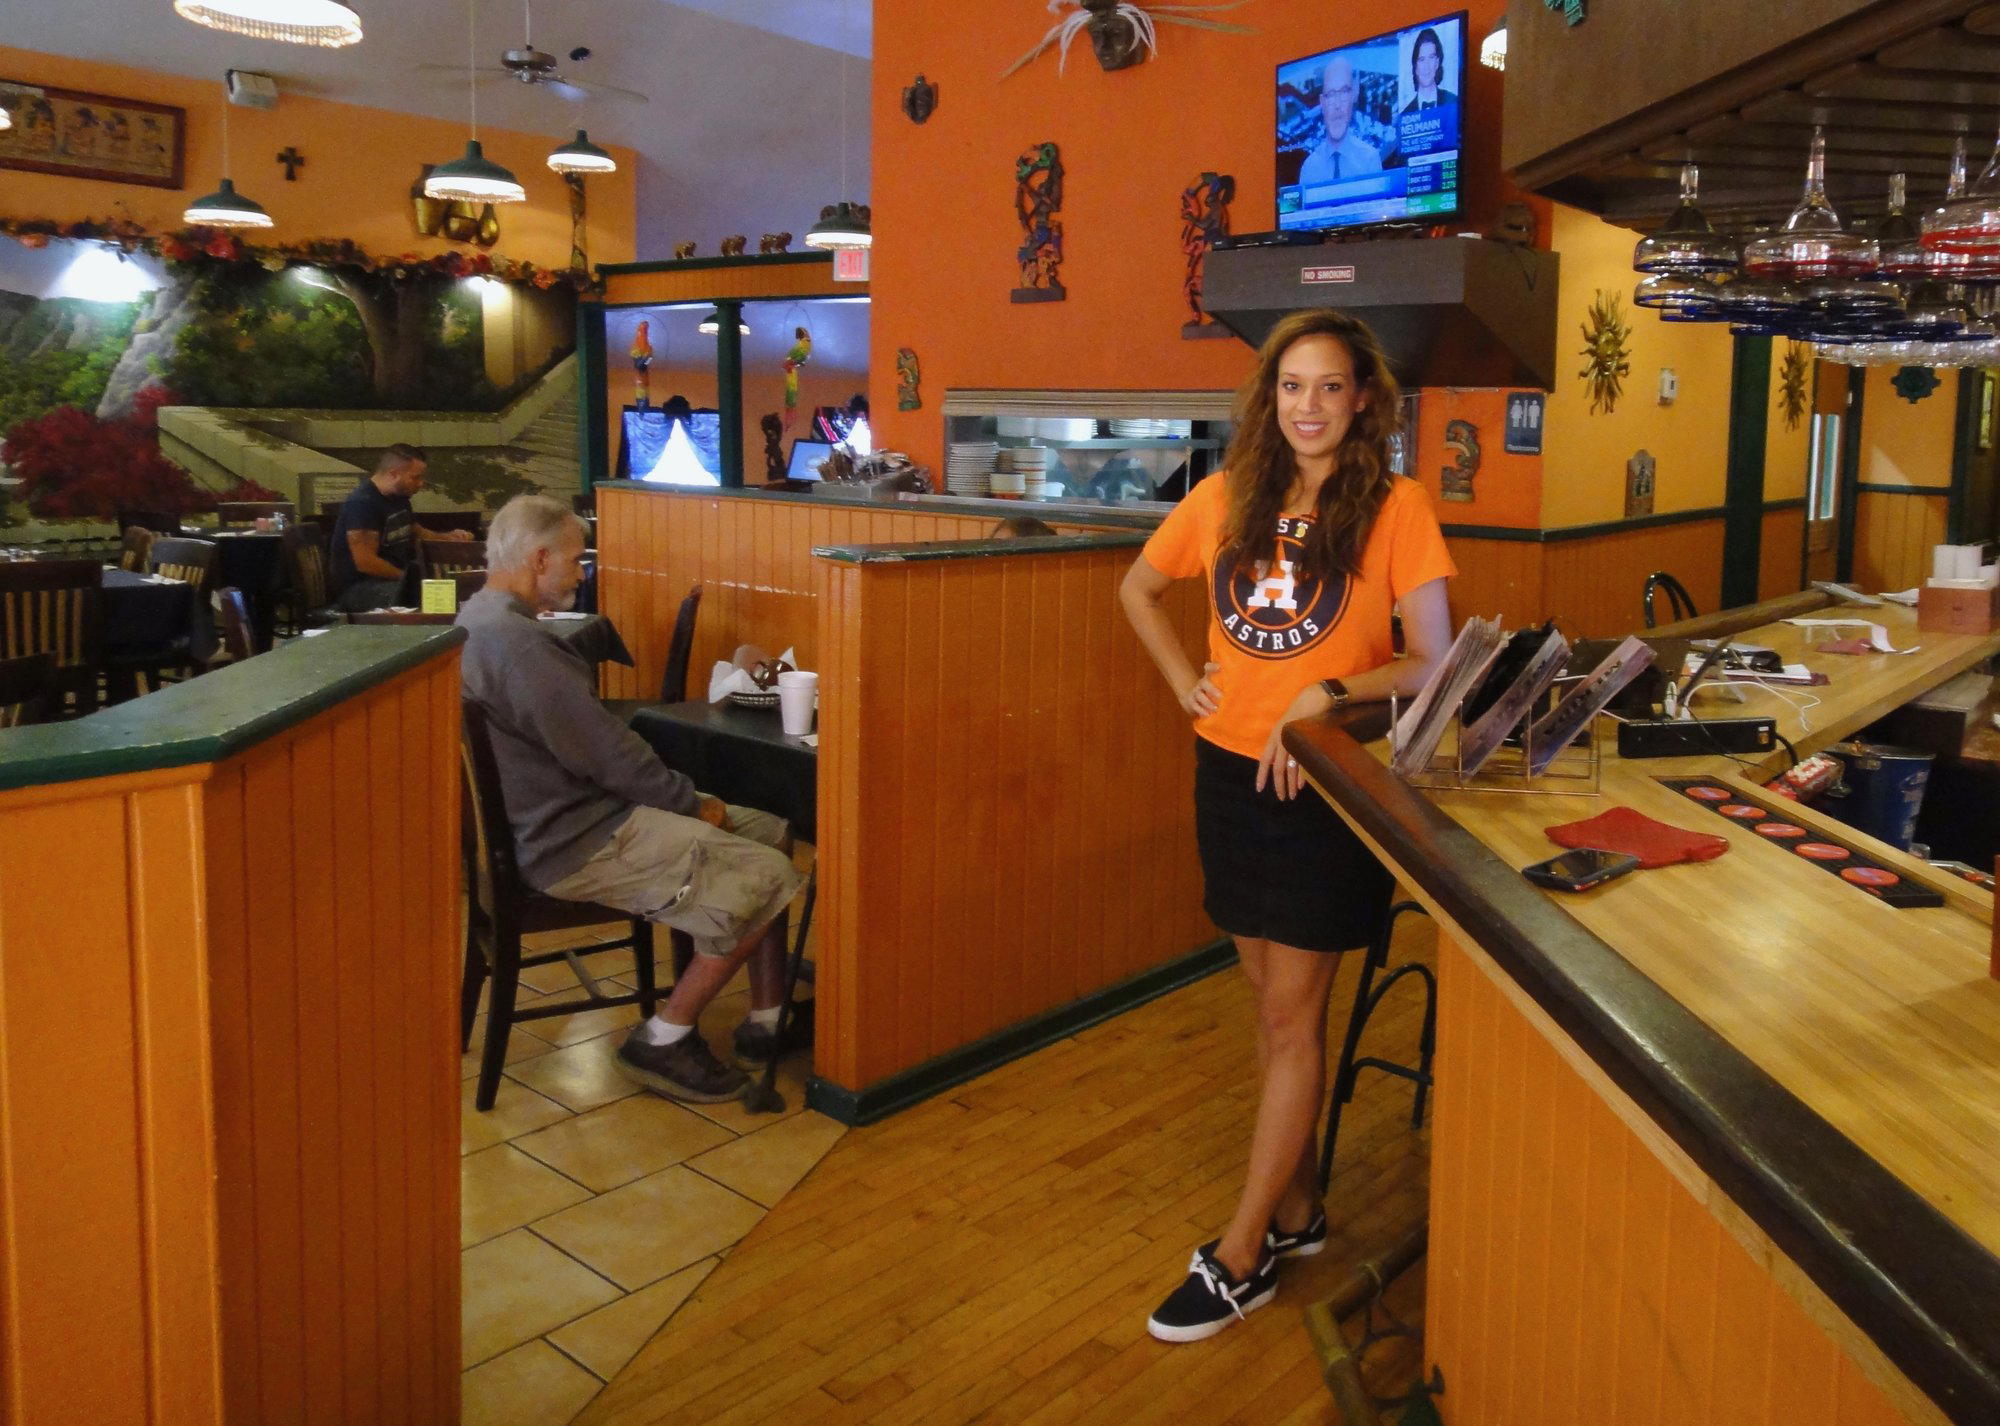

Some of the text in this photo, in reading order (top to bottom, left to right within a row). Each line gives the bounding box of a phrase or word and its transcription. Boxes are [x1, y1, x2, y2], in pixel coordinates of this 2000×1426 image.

[1400, 119, 1441, 135] NEUMANN
[838, 251, 864, 277] EXIT
[1304, 270, 1351, 280] NO SMOKING
[1224, 613, 1319, 650] ASTROS
